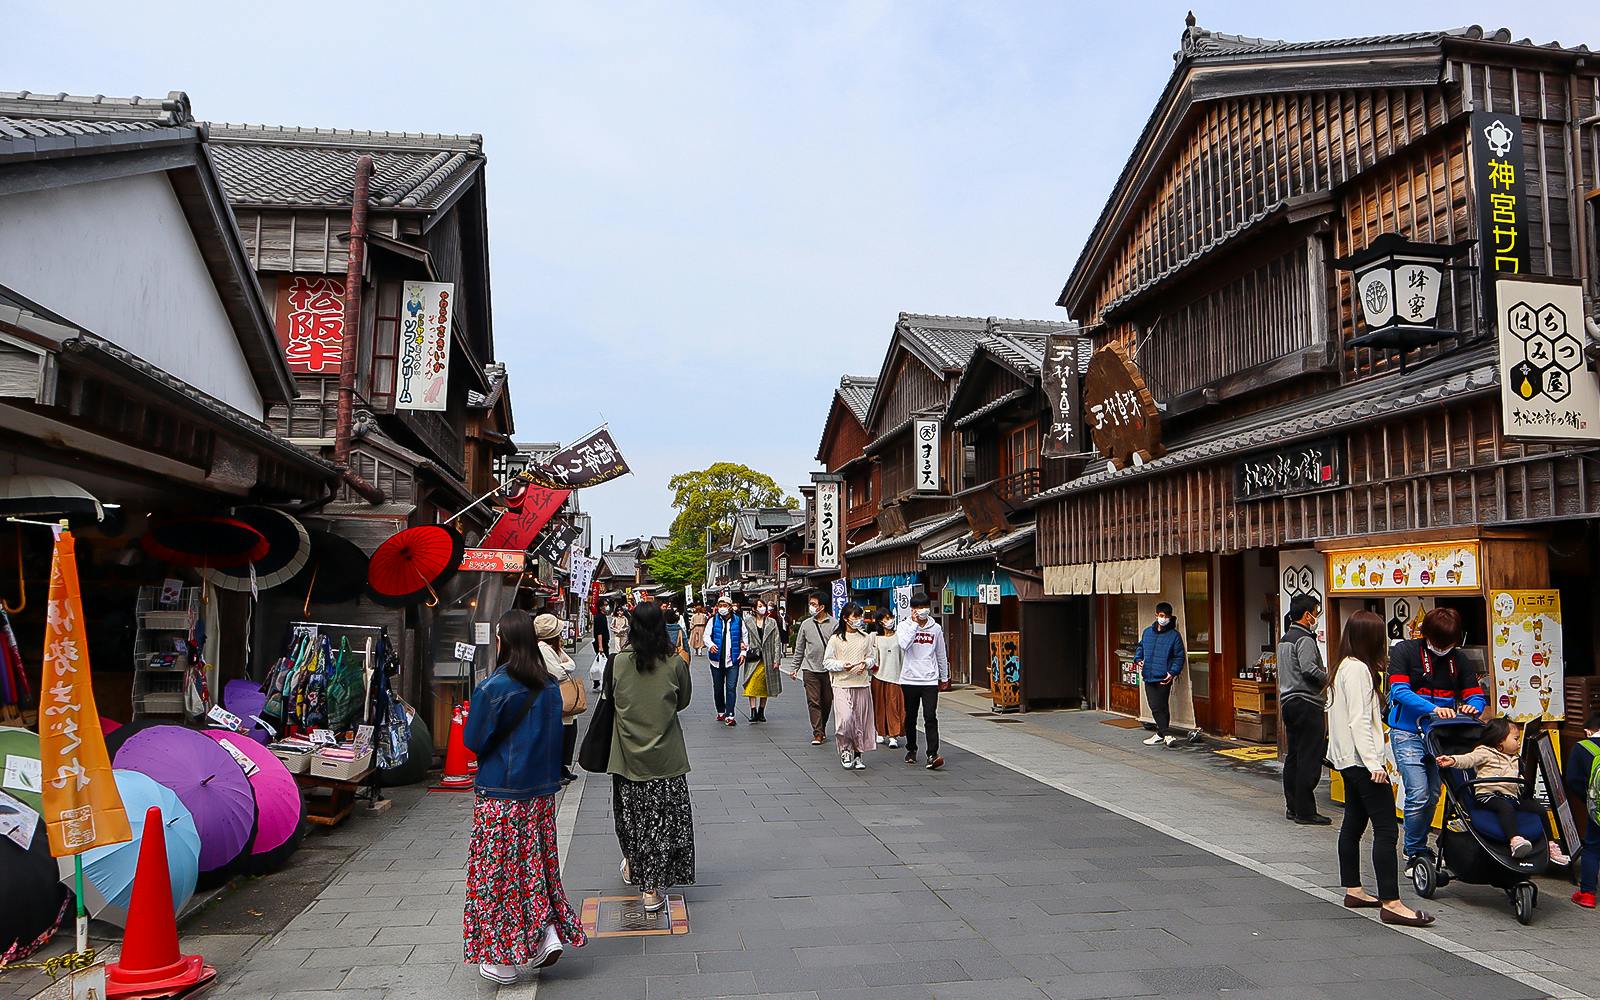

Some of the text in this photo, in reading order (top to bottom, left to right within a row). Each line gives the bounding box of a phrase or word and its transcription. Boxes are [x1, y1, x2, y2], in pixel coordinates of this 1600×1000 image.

[286, 277, 346, 371] 松阪牛
[1408, 269, 1430, 318] 蜂蜜
[399, 320, 417, 403] ソフトクリーム
[921, 443, 935, 485] まる天
